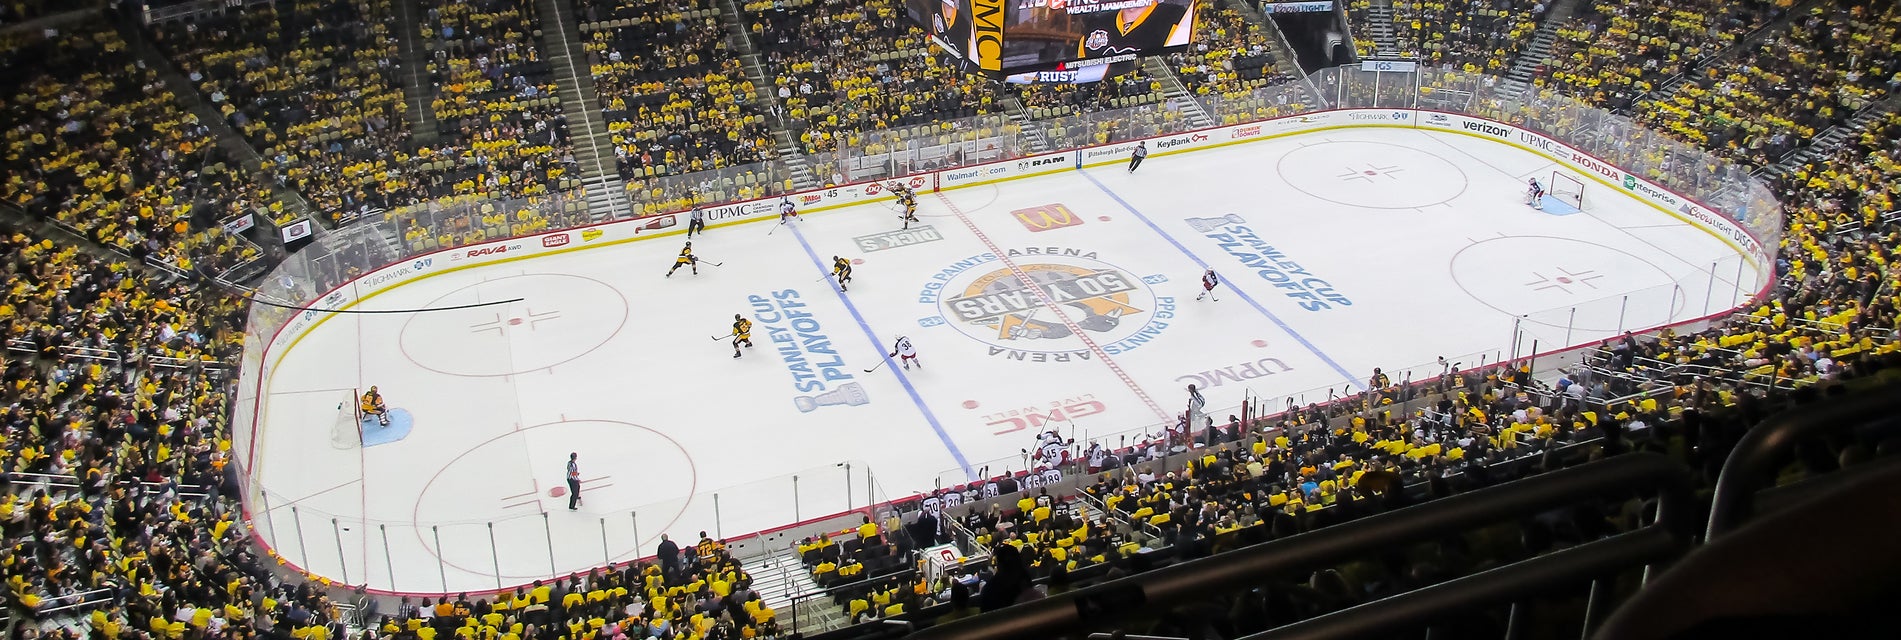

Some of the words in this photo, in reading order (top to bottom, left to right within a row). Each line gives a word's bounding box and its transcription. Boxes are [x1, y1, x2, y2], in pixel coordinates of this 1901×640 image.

[1066, 4, 1099, 14] WEALTH
[1101, 0, 1153, 10] MANAGEMENT
[974, 0, 1003, 60] MC
[1065, 59, 1104, 69] MITSUBISHI
[1104, 54, 1137, 64] ELECTRIC
[1040, 71, 1077, 82] RUST
[1463, 121, 1508, 138] verizon
[1157, 137, 1190, 148] KeyBank
[1520, 132, 1555, 152] UPMC
[1032, 156, 1065, 167] RAM
[1572, 154, 1620, 181] HONDA
[947, 170, 978, 182] Walmart
[1628, 177, 1676, 205] enterprise
[708, 204, 751, 221] UPMC
[1690, 206, 1713, 225] Coors
[1713, 219, 1732, 236] LIGHT
[466, 244, 508, 259] RAV4
[508, 244, 522, 252] AWD
[1008, 246, 1099, 260] ARENA
[1206, 233, 1331, 312] PLAYOFFS
[1224, 225, 1312, 277] STANLEY
[1301, 277, 1352, 306] CUP
[919, 280, 942, 304] PPG
[933, 252, 997, 281] PAINTS
[1075, 273, 1124, 295] 50
[748, 294, 782, 324] CUP
[957, 283, 1076, 319] YEARS
[1156, 296, 1175, 319] PPG
[772, 289, 854, 382] PLAYOFFS
[1102, 321, 1169, 356] PAINTS
[765, 325, 825, 393] STANLEY
[988, 345, 1091, 363] ARENA
[1174, 357, 1295, 392] UPMC
[1050, 393, 1095, 407] LIVE
[981, 406, 1039, 421] WELL
[985, 400, 1106, 436] GNC
[1046, 449, 1057, 459] 45
[1049, 474, 1059, 484] 89
[929, 502, 938, 512] 10
[700, 544, 711, 555] 72
